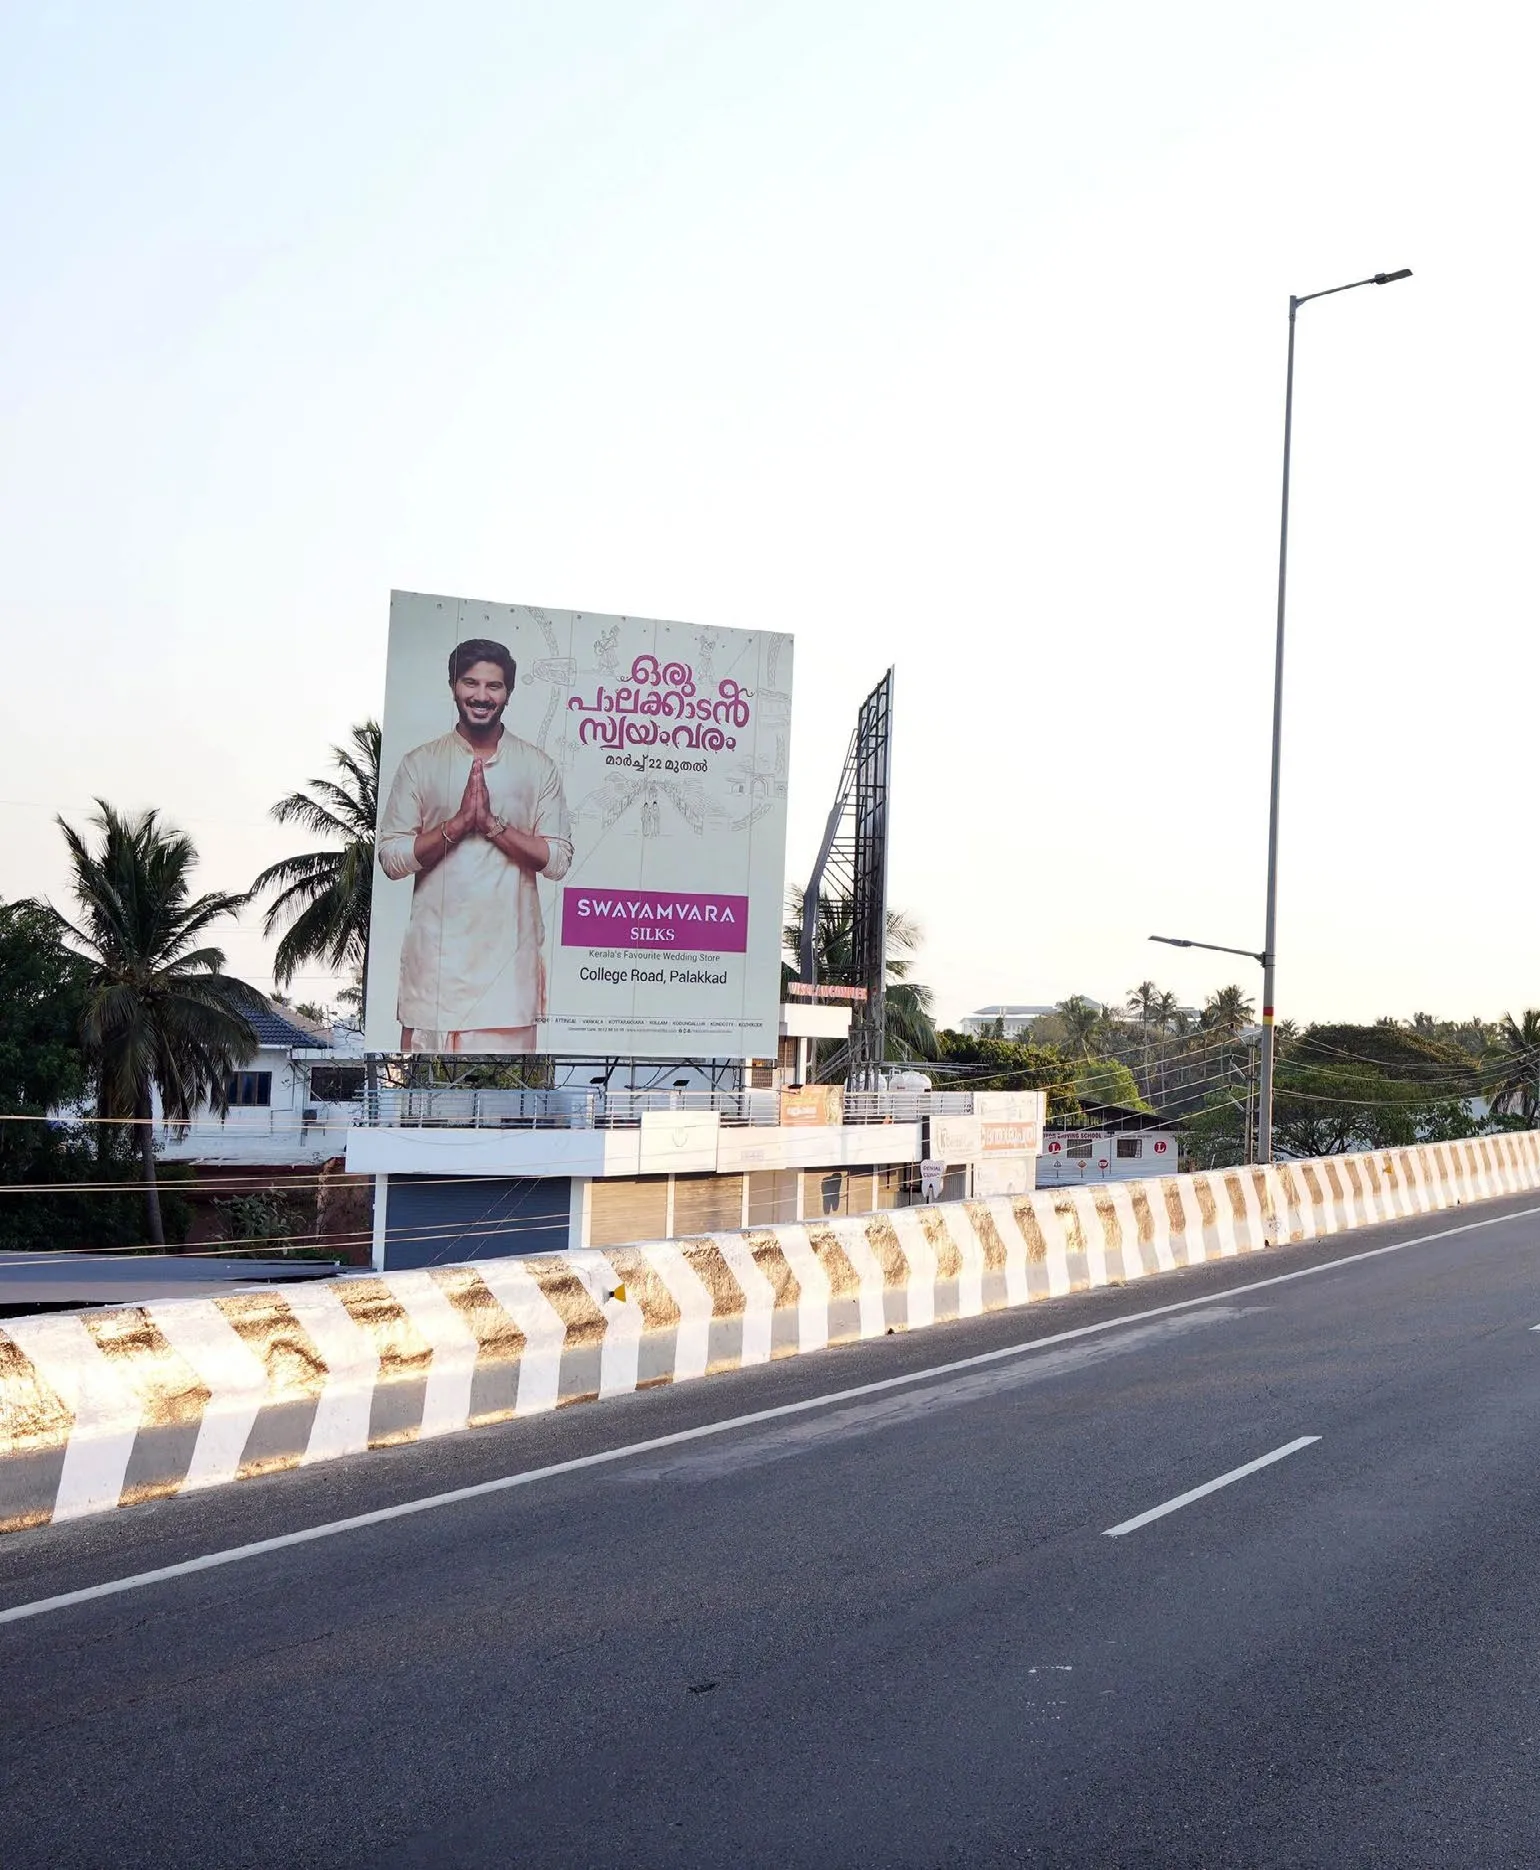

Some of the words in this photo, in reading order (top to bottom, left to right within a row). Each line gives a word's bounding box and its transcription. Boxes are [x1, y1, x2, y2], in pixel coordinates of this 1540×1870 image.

[618, 654, 697, 698] ഒരു
[648, 757, 663, 770] 22
[664, 758, 708, 774] മുതൽ
[577, 898, 735, 923] SWAYAMVARA
[630, 927, 675, 941] SILKS
[588, 949, 622, 960] Kerala's
[623, 950, 662, 961] Favourite
[663, 951, 698, 963] Wedding
[699, 953, 721, 962] Store
[579, 967, 628, 984] College
[630, 969, 667, 984] Road,
[669, 970, 728, 985] Palakkad
[1080, 1131, 1102, 1139] SCHOOL
